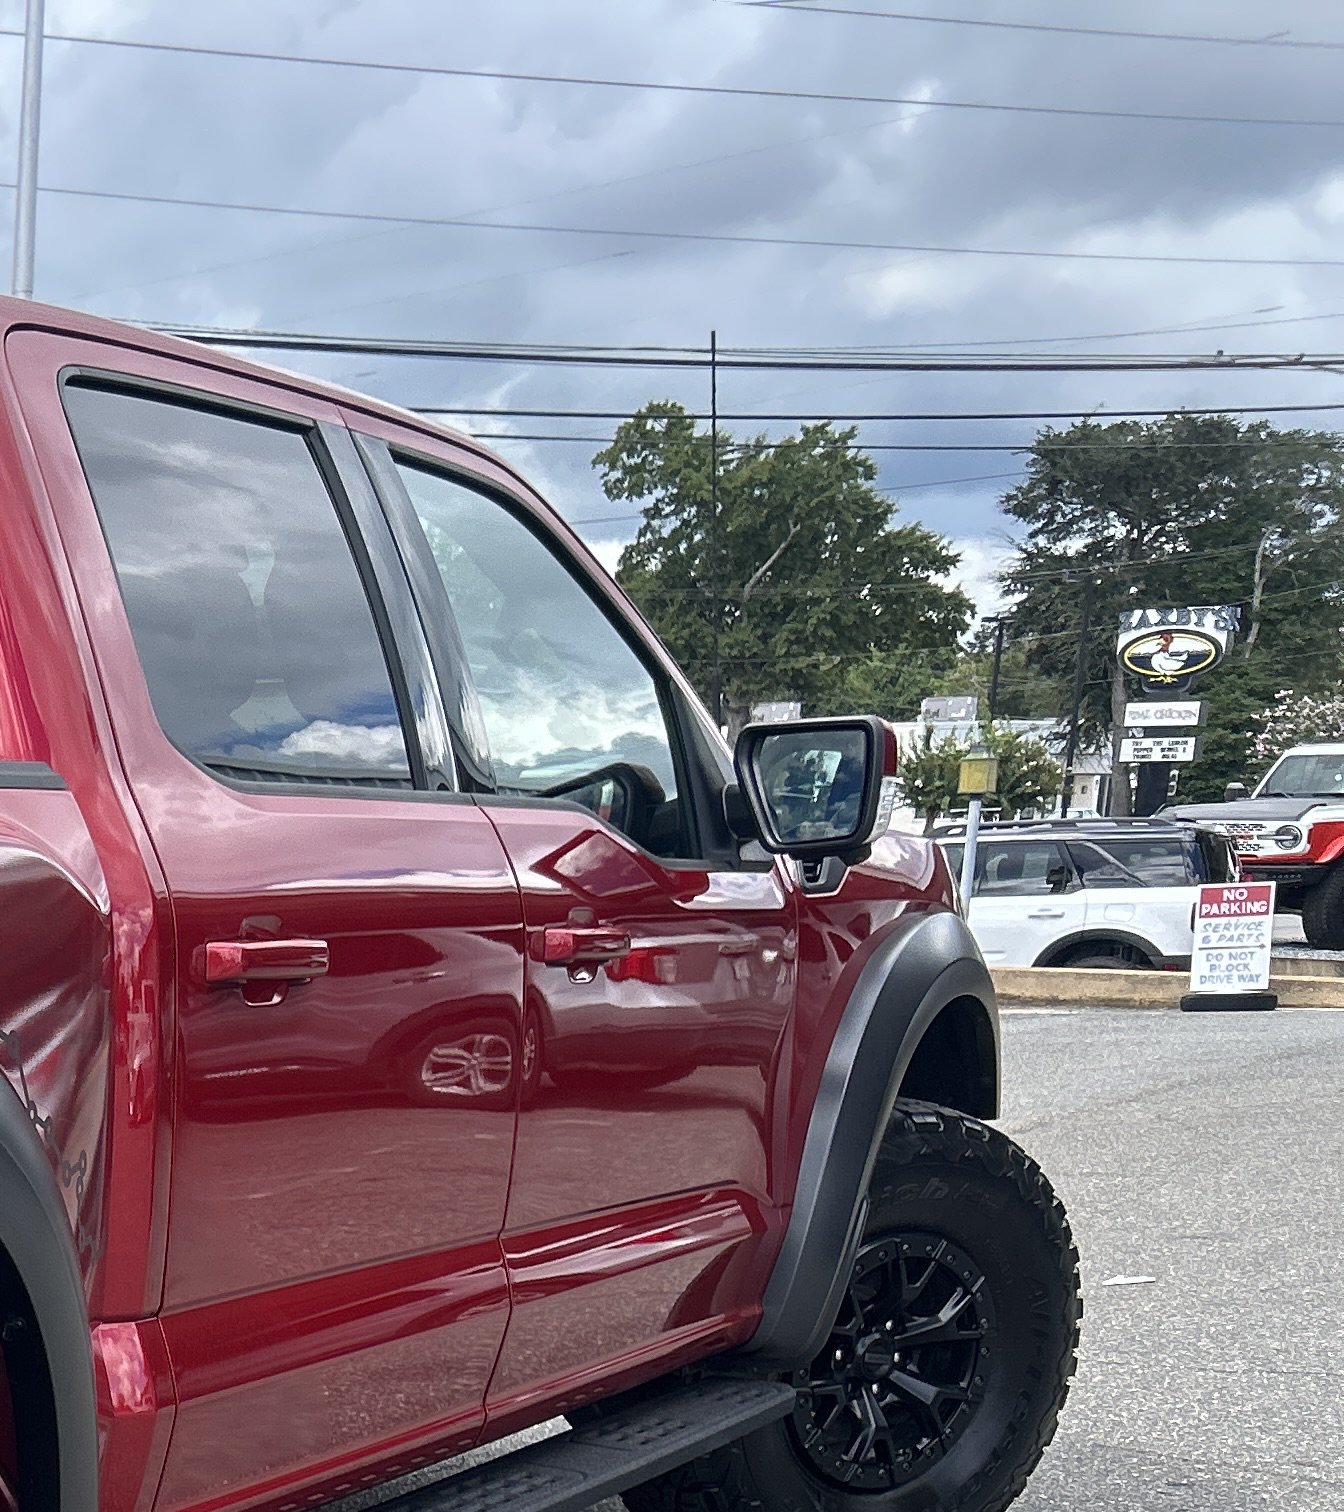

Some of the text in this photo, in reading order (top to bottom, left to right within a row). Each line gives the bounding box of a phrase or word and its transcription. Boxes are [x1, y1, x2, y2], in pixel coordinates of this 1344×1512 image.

[1223, 888, 1248, 901] NO
[1201, 901, 1268, 915] PARKING
[1201, 920, 1265, 933] SERVICE
[1216, 933, 1265, 943] PARTS
[1206, 951, 1256, 962] DO NOT
[1210, 963, 1252, 973] BLOCK
[1199, 974, 1262, 985] DRIVE WAY
